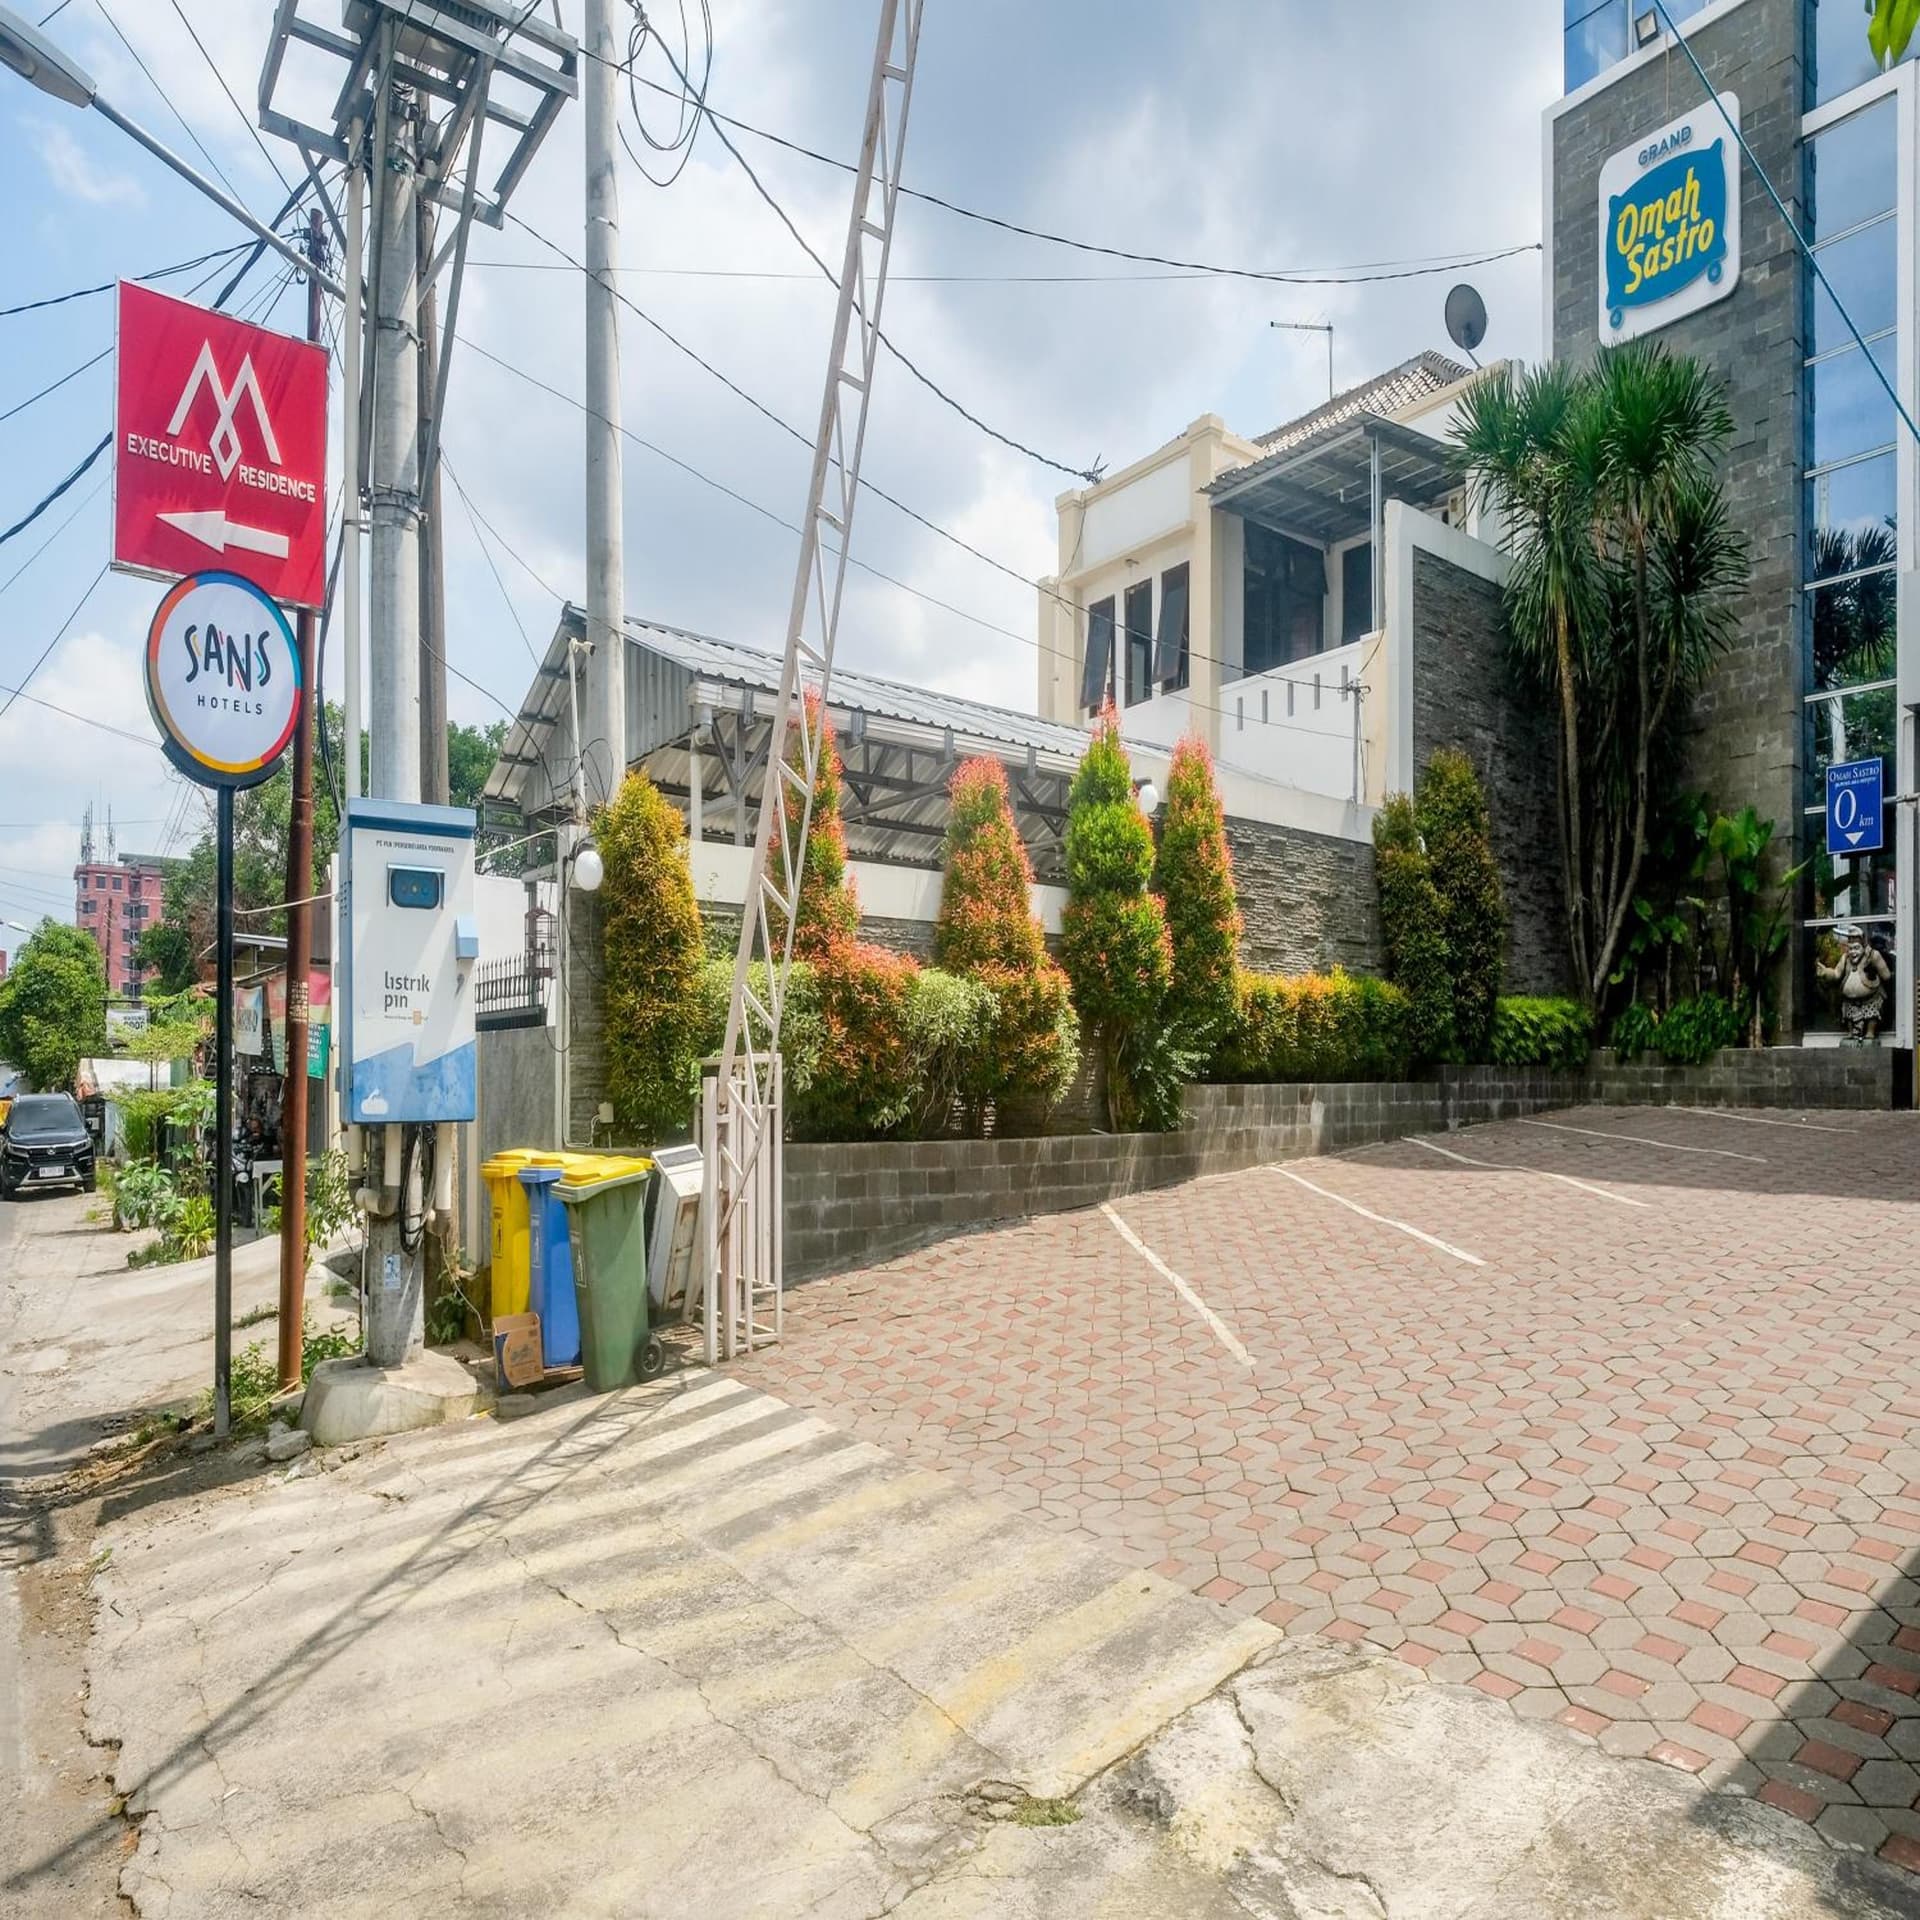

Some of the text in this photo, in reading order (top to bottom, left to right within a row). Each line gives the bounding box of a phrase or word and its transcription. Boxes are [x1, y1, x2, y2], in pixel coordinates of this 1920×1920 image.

[1638, 126, 1692, 166] GRAND
[1617, 166, 1701, 255] Omah
[1624, 218, 1715, 294] Sastro
[127, 433, 316, 503] EXECUTIVE RESIDENCE
[184, 623, 271, 692] SANS
[197, 695, 263, 715] HOTELS
